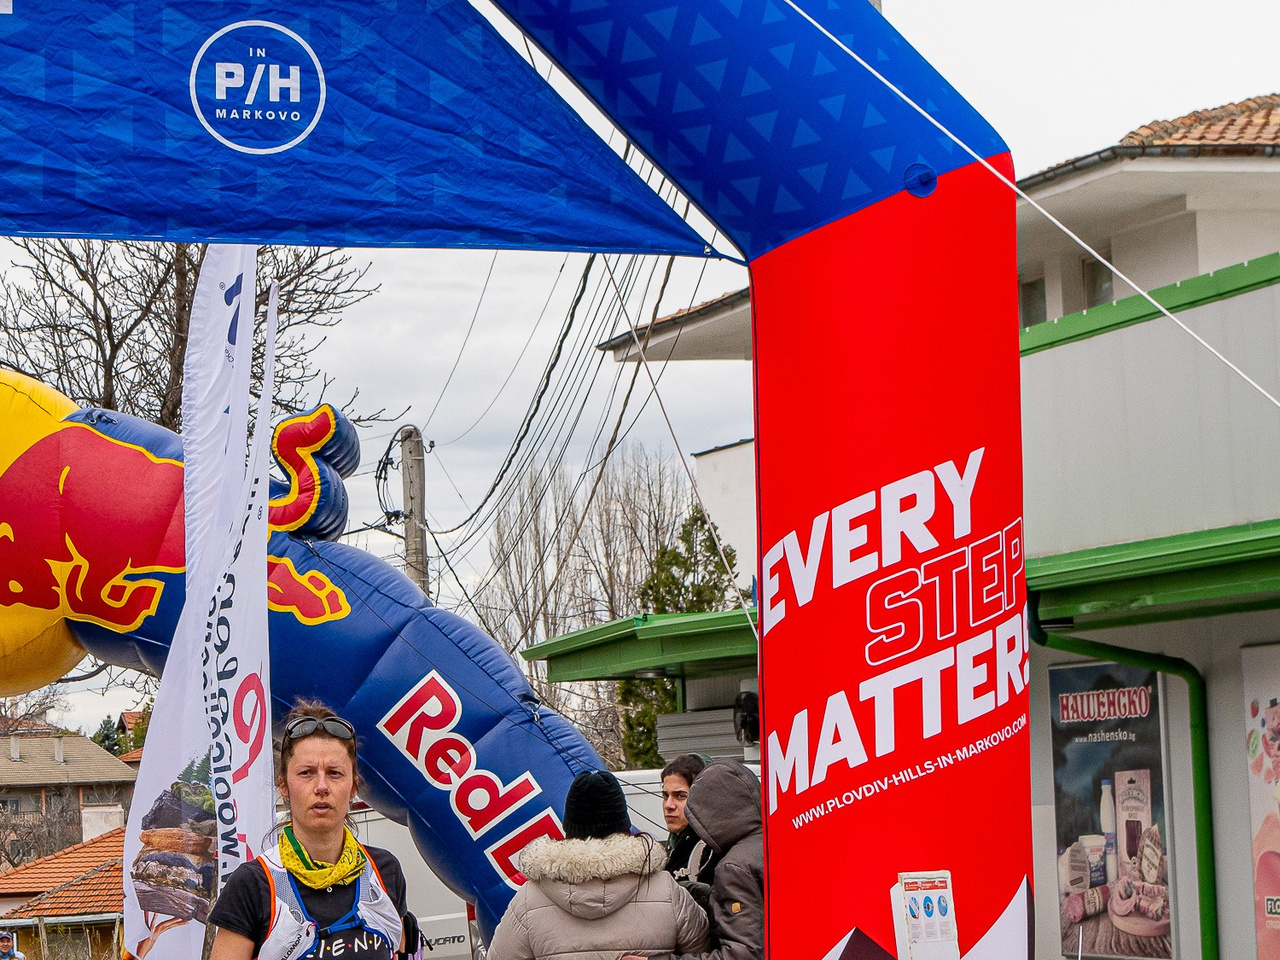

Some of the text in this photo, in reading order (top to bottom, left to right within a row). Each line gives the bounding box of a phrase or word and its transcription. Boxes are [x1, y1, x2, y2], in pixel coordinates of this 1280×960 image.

[215, 62, 301, 105] P/H
[248, 47, 266, 58] IN
[215, 108, 301, 121] MARKOVO
[762, 446, 986, 637] EVERY
[864, 516, 1025, 667] STEP
[1059, 687, 1150, 723] НАШЕНСКО
[379, 672, 540, 838] Red
[791, 712, 1028, 830] WWW.PLOVDIV-HILLS-IN-MARKOVO.COM
